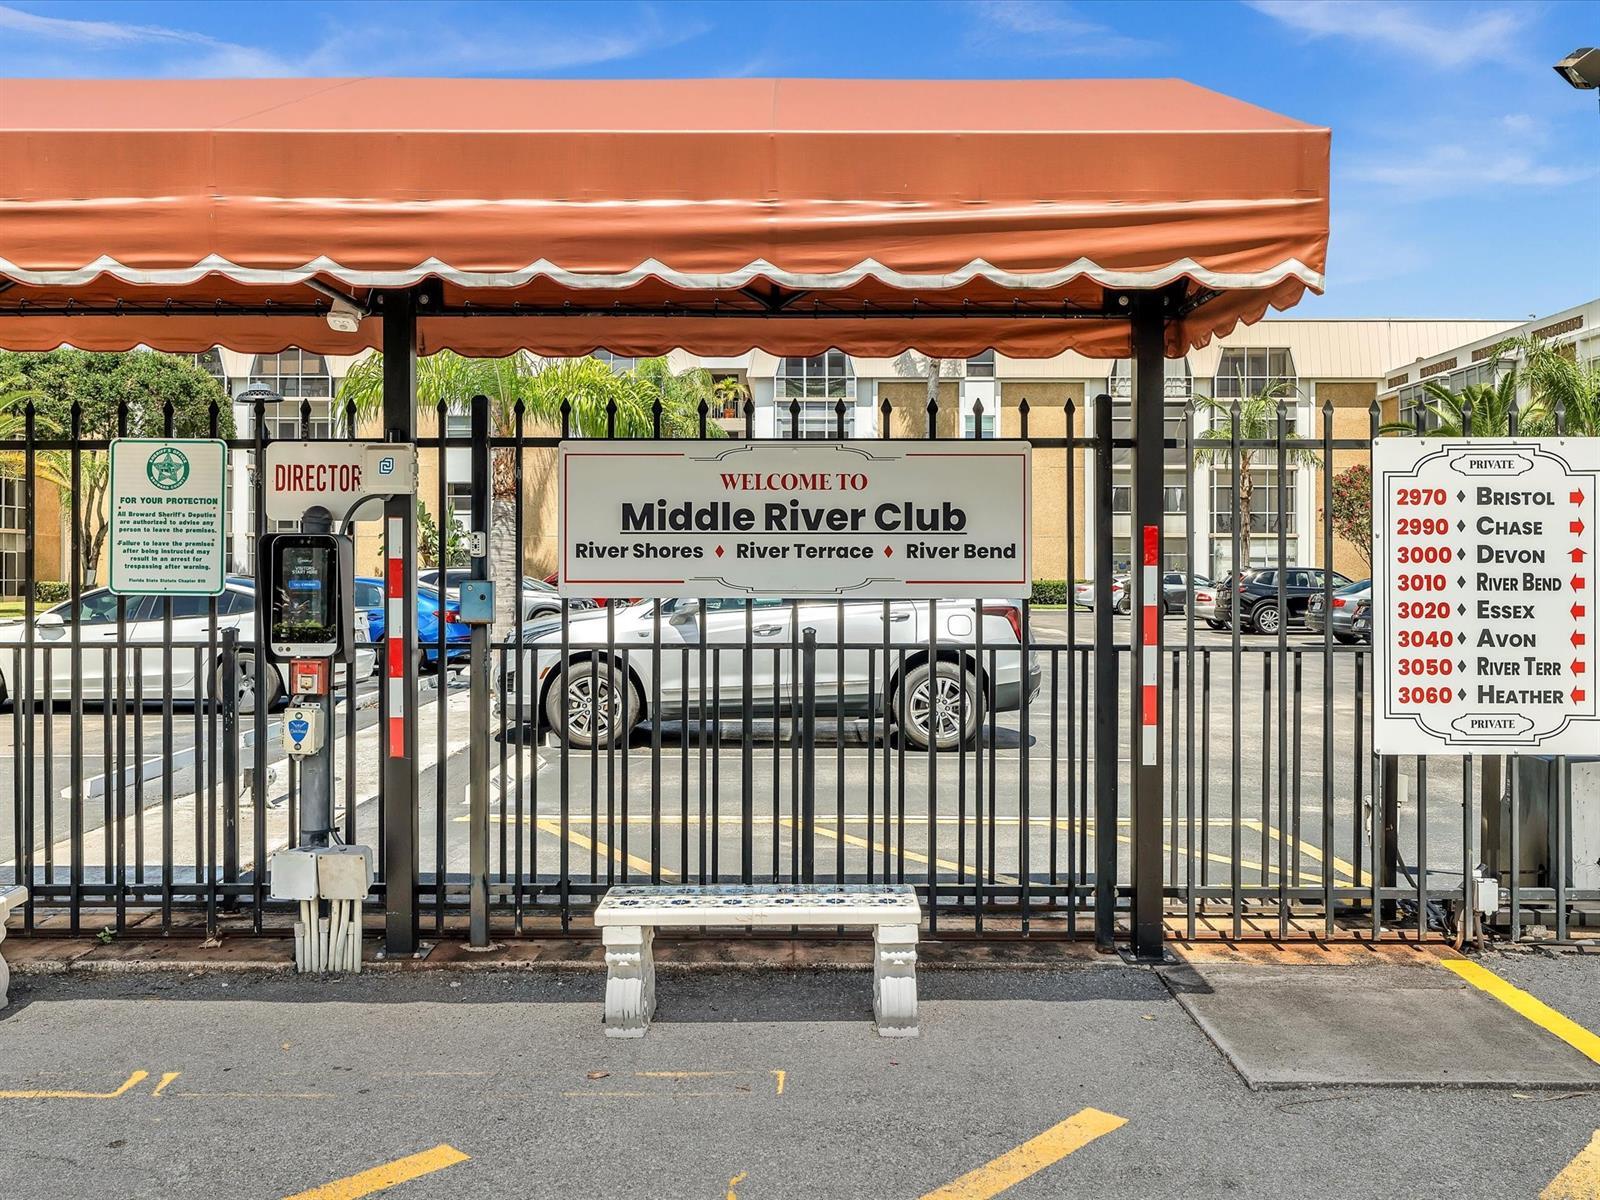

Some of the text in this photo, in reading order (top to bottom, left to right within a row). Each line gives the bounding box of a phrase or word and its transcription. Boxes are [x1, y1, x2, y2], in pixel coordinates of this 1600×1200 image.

[1469, 459, 1515, 469] PRIVATE
[276, 465, 362, 492] DIRECTOR
[720, 474, 867, 490] WELCOME TO
[1397, 487, 1554, 505] 2970 BRISTOL
[622, 499, 967, 531] Middle River Club
[1397, 516, 1543, 535] 2990 CHASE
[576, 542, 1016, 558] River Shores River Terrace River Bend
[1397, 545, 1545, 563] 3000 DEVON
[1397, 573, 1562, 591] 3010 RIVER BEND
[1397, 600, 1536, 618] 3020 ESSEX
[1398, 629, 1537, 647] 3040 AVON
[1398, 657, 1562, 675] 3050 RIVER TERR
[1398, 685, 1564, 703] 3060 HEATHER
[1470, 719, 1516, 729] PRIVATE
